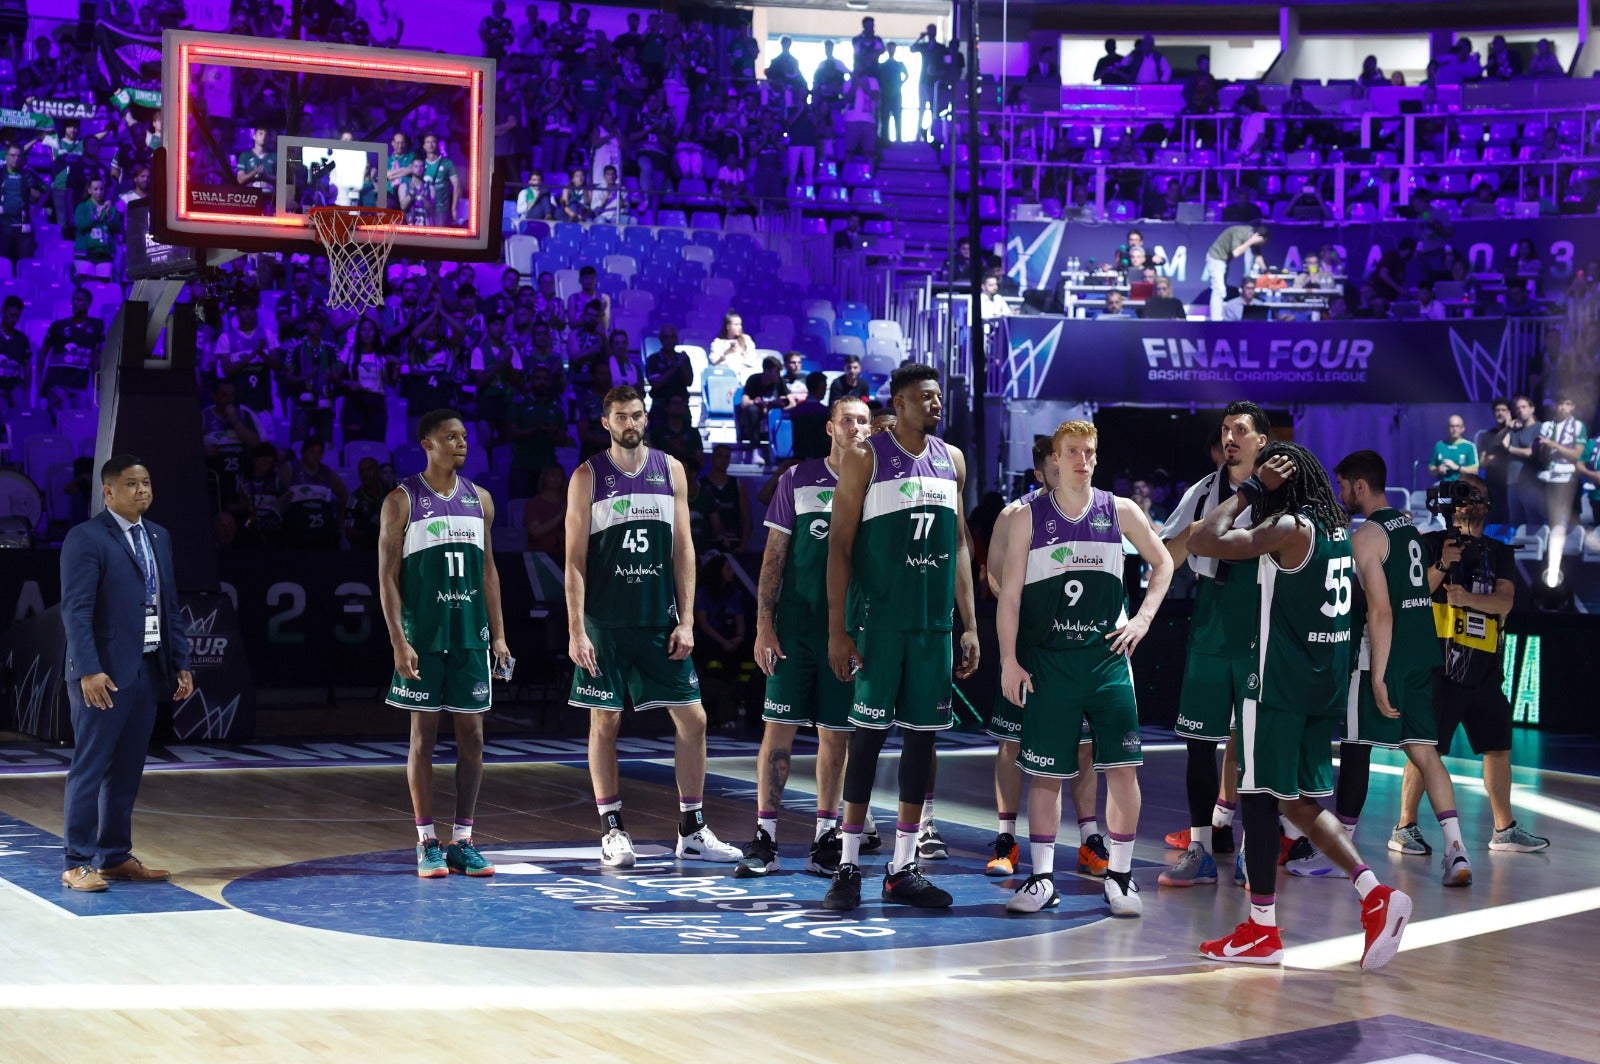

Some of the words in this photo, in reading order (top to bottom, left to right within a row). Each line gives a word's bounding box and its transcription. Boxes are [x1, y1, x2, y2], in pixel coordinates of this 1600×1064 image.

[32, 100, 109, 118] UNICAJA
[191, 191, 226, 203] FINAL
[227, 193, 258, 204] FOUR
[1141, 338, 1260, 369] FINAL
[1268, 339, 1375, 369] FOUR
[1147, 369, 1233, 381] BASKETBALL
[1234, 371, 1314, 382] CHAMPIONS
[1316, 371, 1368, 383] LEAGUE
[631, 506, 660, 516] Unicaja
[448, 528, 475, 539] Unicaja
[910, 512, 936, 541] 77
[621, 528, 649, 553] 45
[444, 551, 465, 577] 11
[1072, 554, 1104, 566] Unicaja
[1408, 539, 1424, 587] 8
[1064, 579, 1084, 607] 9
[1320, 556, 1352, 618] 55
[1051, 619, 1101, 633] Andalucía
[392, 685, 430, 701] málaga
[576, 685, 614, 701] málaga
[764, 698, 791, 713] álaga
[853, 702, 886, 719] málaga
[1177, 713, 1204, 730] álaga
